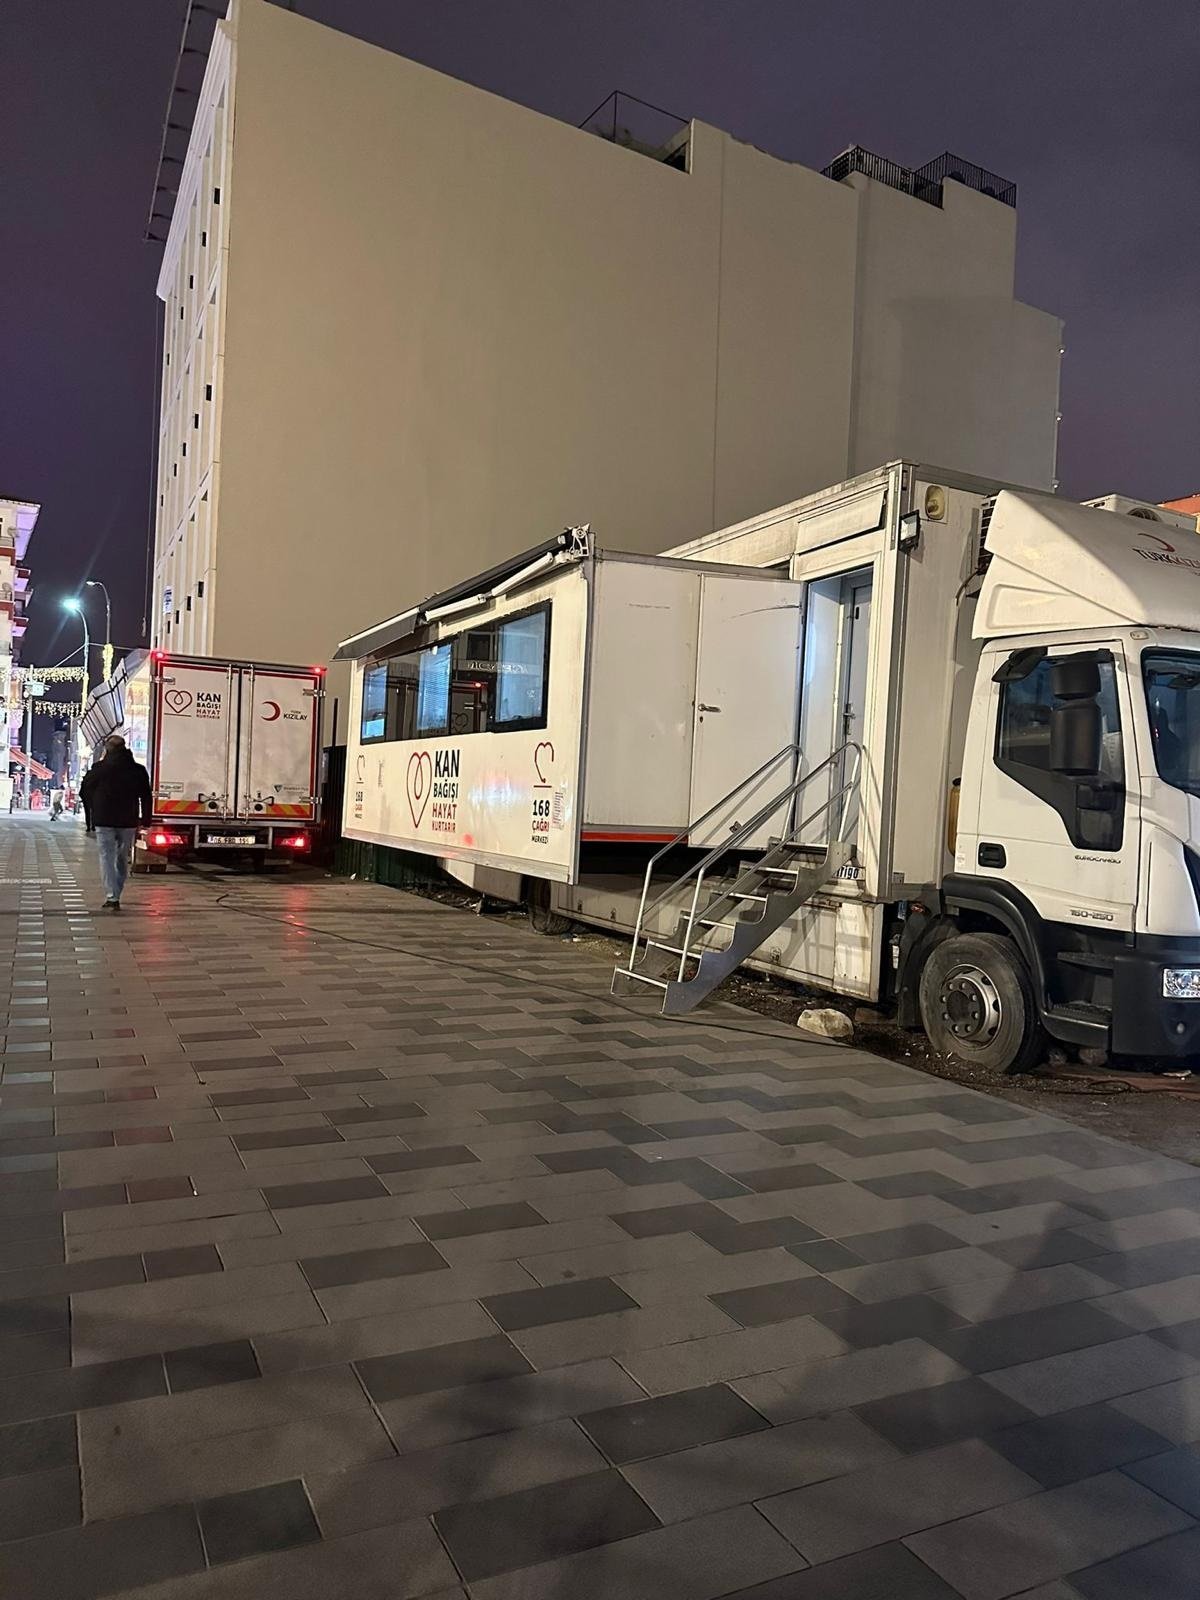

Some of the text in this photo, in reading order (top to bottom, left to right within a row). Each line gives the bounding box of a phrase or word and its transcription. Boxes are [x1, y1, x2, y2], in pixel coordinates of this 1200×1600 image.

[196, 692, 221, 703] KAN
[196, 702, 221, 710] BAĞIŞI
[434, 749, 460, 778] KAN
[433, 779, 459, 802] BAĞIŞI
[432, 803, 457, 820] HAYAT
[532, 799, 551, 817] 168
[531, 818, 550, 833] ÇAĞRI
